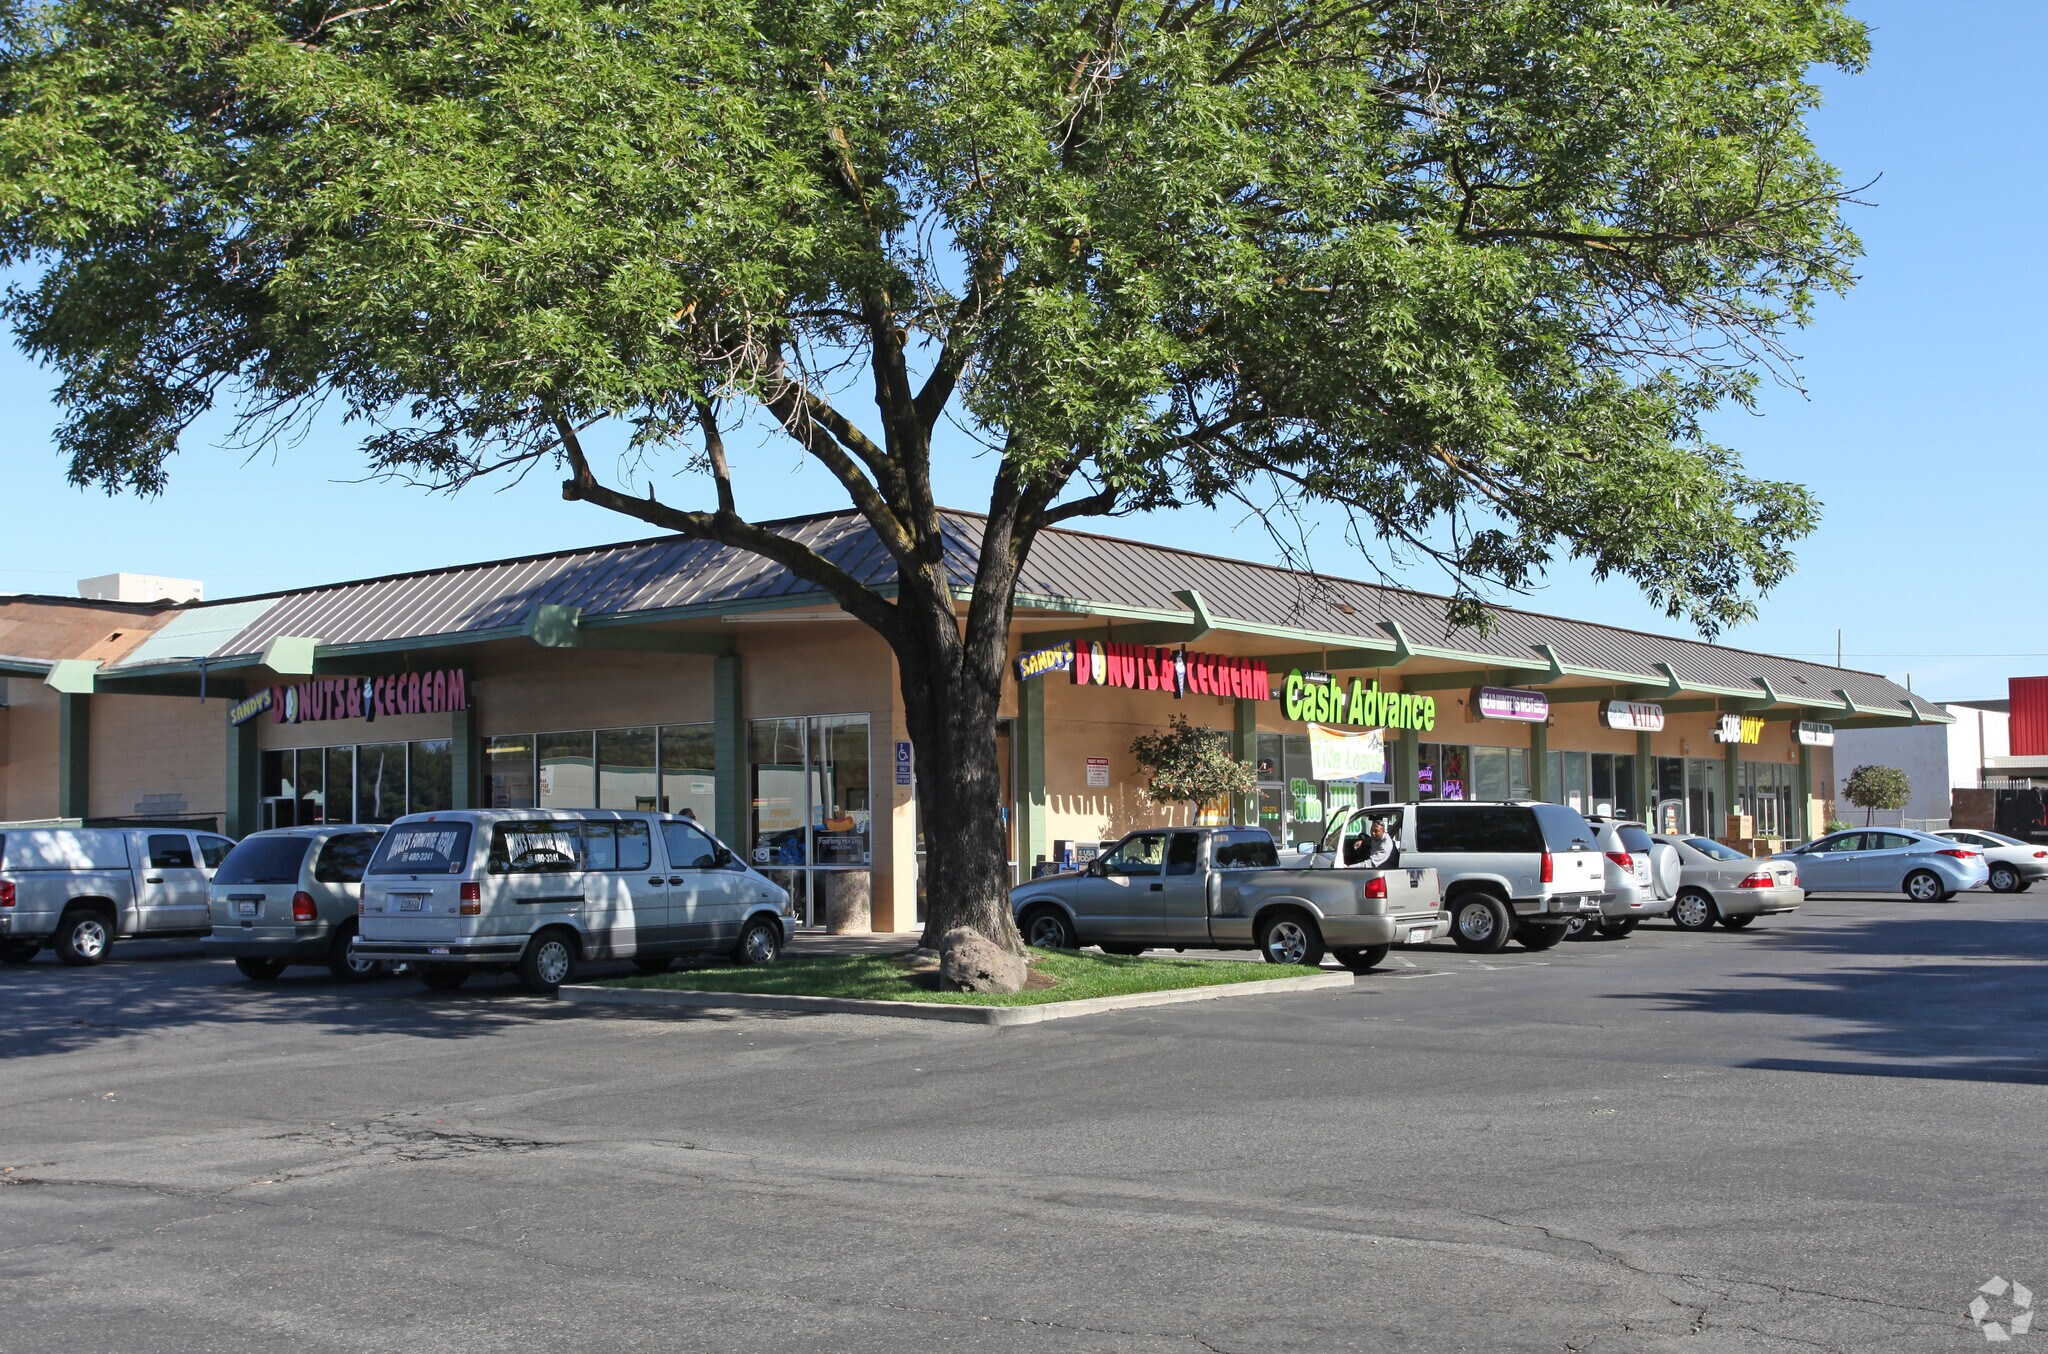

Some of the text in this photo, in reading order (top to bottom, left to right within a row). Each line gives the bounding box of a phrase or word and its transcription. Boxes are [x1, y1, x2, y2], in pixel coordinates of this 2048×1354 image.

[1020, 641, 1074, 678] SANDY'S
[230, 690, 271, 724] SANDY'S
[1286, 668, 1436, 732] Cash Advance
[1628, 704, 1661, 729] NAILS
[1720, 713, 1765, 745] SUBWAY
[1345, 748, 1381, 772] Loans
[1290, 778, 1317, 799] $50 TO
[1330, 786, 1356, 807] TITLE
[1295, 801, 1321, 821] 5,000
